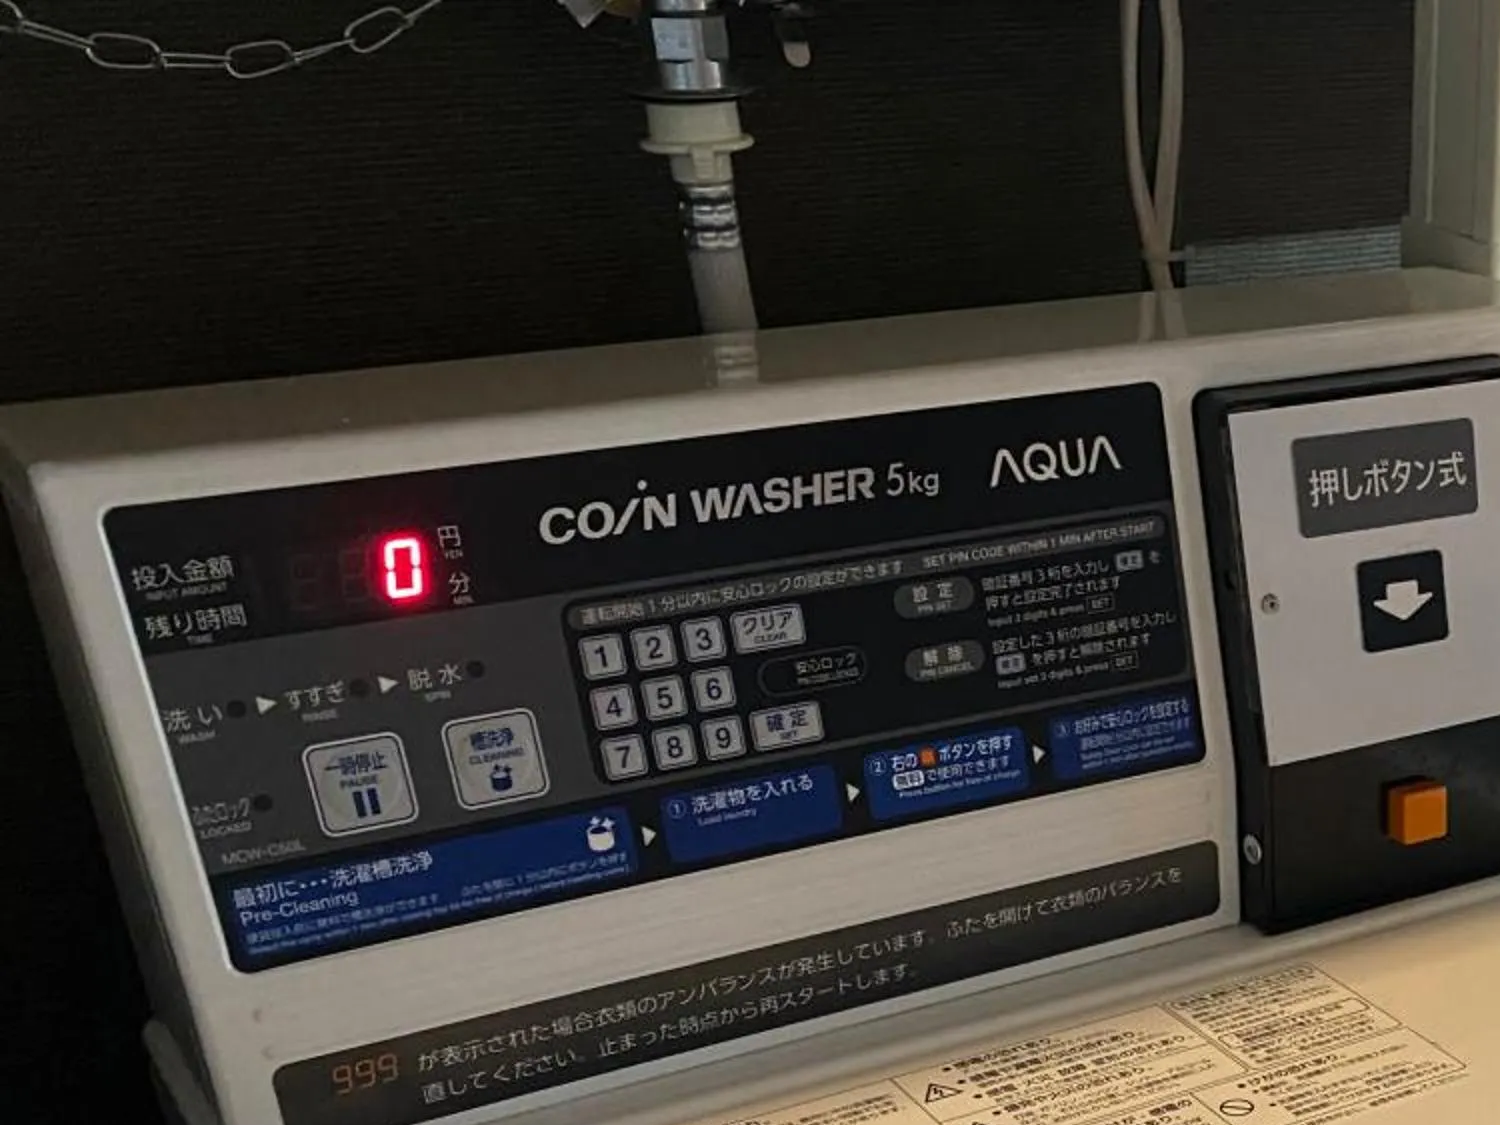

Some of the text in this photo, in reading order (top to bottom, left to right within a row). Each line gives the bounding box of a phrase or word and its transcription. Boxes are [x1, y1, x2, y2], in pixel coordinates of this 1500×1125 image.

[989, 435, 1123, 489] AQUA
[1309, 450, 1468, 509] 押しボタン式
[538, 462, 941, 545] COIN WASHER 5kg
[436, 524, 462, 548] 円
[921, 552, 948, 569] SET
[970, 544, 1003, 561] CODE
[1082, 526, 1118, 544] AFTER
[1118, 520, 1154, 538] START
[129, 554, 235, 590] 投入金額
[383, 537, 424, 600] 0
[447, 571, 473, 595] 分
[142, 603, 249, 640] 残り時間
[741, 610, 795, 634] クリア
[644, 635, 664, 660] 2
[694, 626, 713, 651] 3
[593, 645, 609, 669] 1
[406, 662, 463, 691] 脱水
[704, 676, 723, 701] 6
[284, 680, 349, 711] すすぎ
[603, 695, 624, 719] 4
[654, 685, 674, 710] 5
[765, 708, 809, 733] 確定
[664, 734, 685, 760] 8
[713, 725, 733, 751] 9
[323, 751, 388, 779] 一時停止
[468, 746, 525, 766] CLEANING
[615, 744, 634, 770] 7
[339, 773, 378, 790] PAUSE
[690, 773, 814, 815] 洗濯物を入れる
[199, 820, 252, 840] LOCKED
[238, 888, 360, 930] Pre-Cleaning
[333, 1052, 399, 1097] 999
